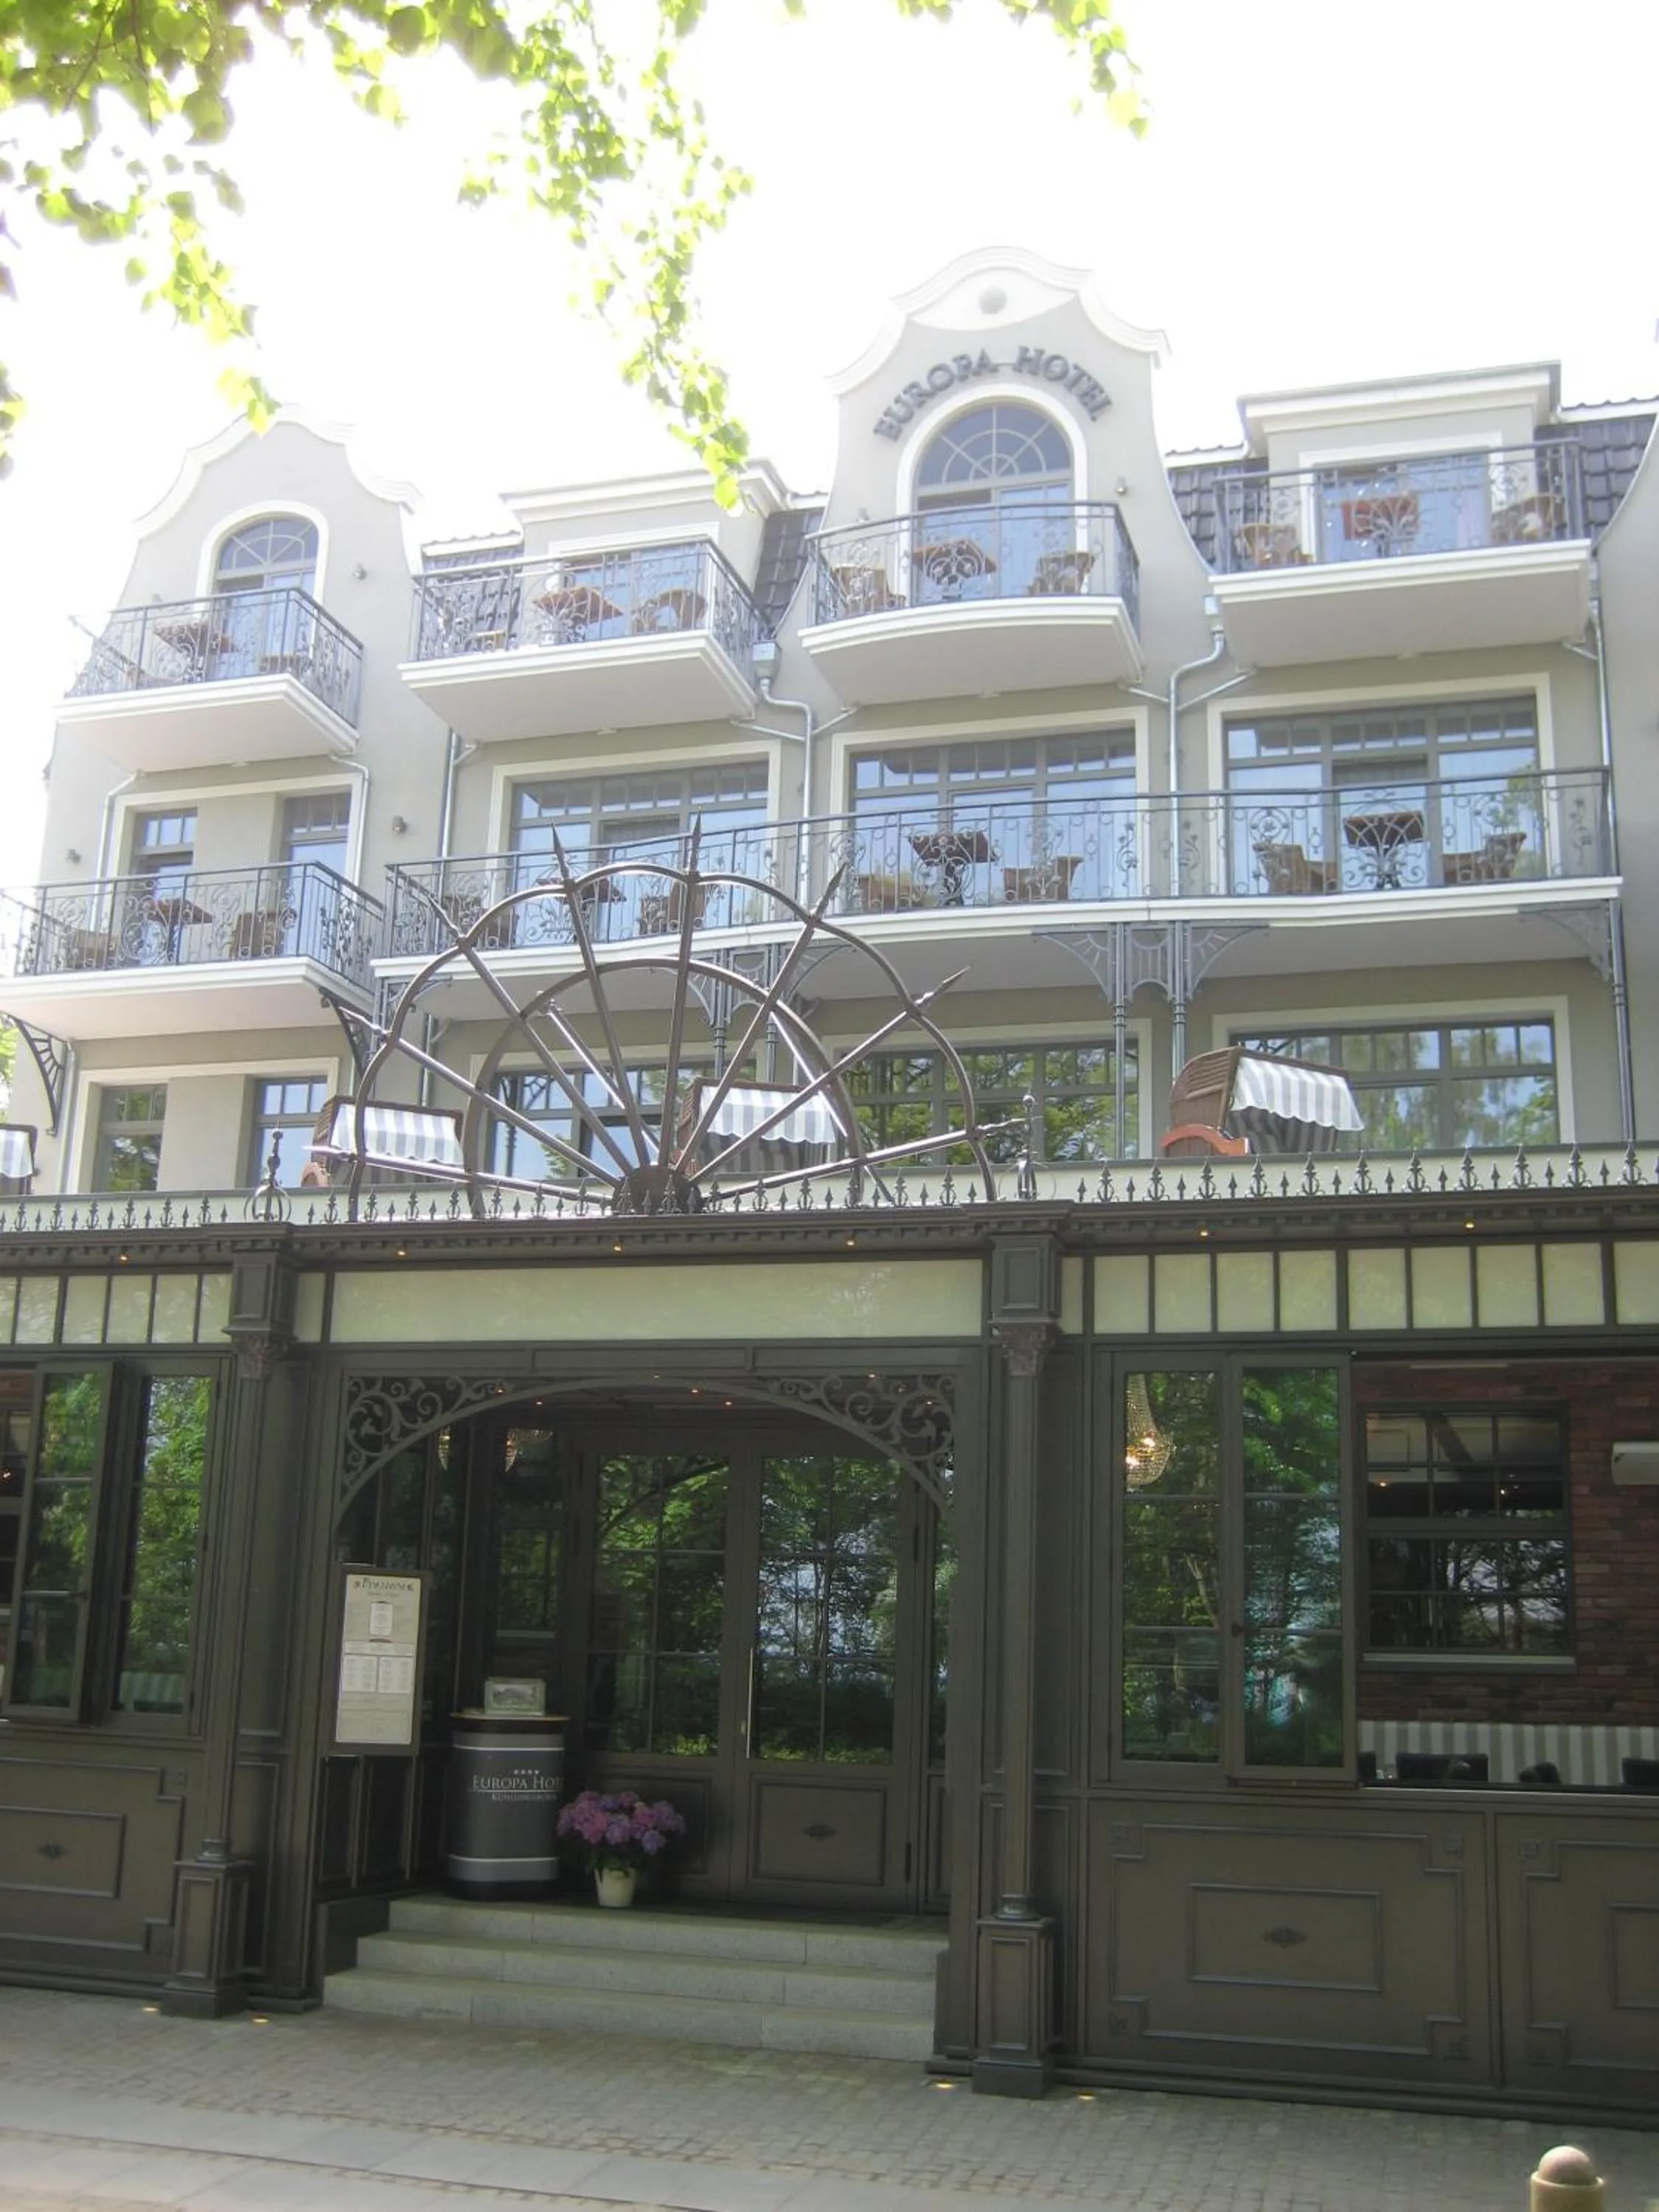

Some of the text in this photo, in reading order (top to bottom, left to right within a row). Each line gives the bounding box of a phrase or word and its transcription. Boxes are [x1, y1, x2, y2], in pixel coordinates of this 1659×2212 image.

[873, 345, 1113, 442] EUROPA HOTEL
[472, 1775, 528, 1790] EUROPA
